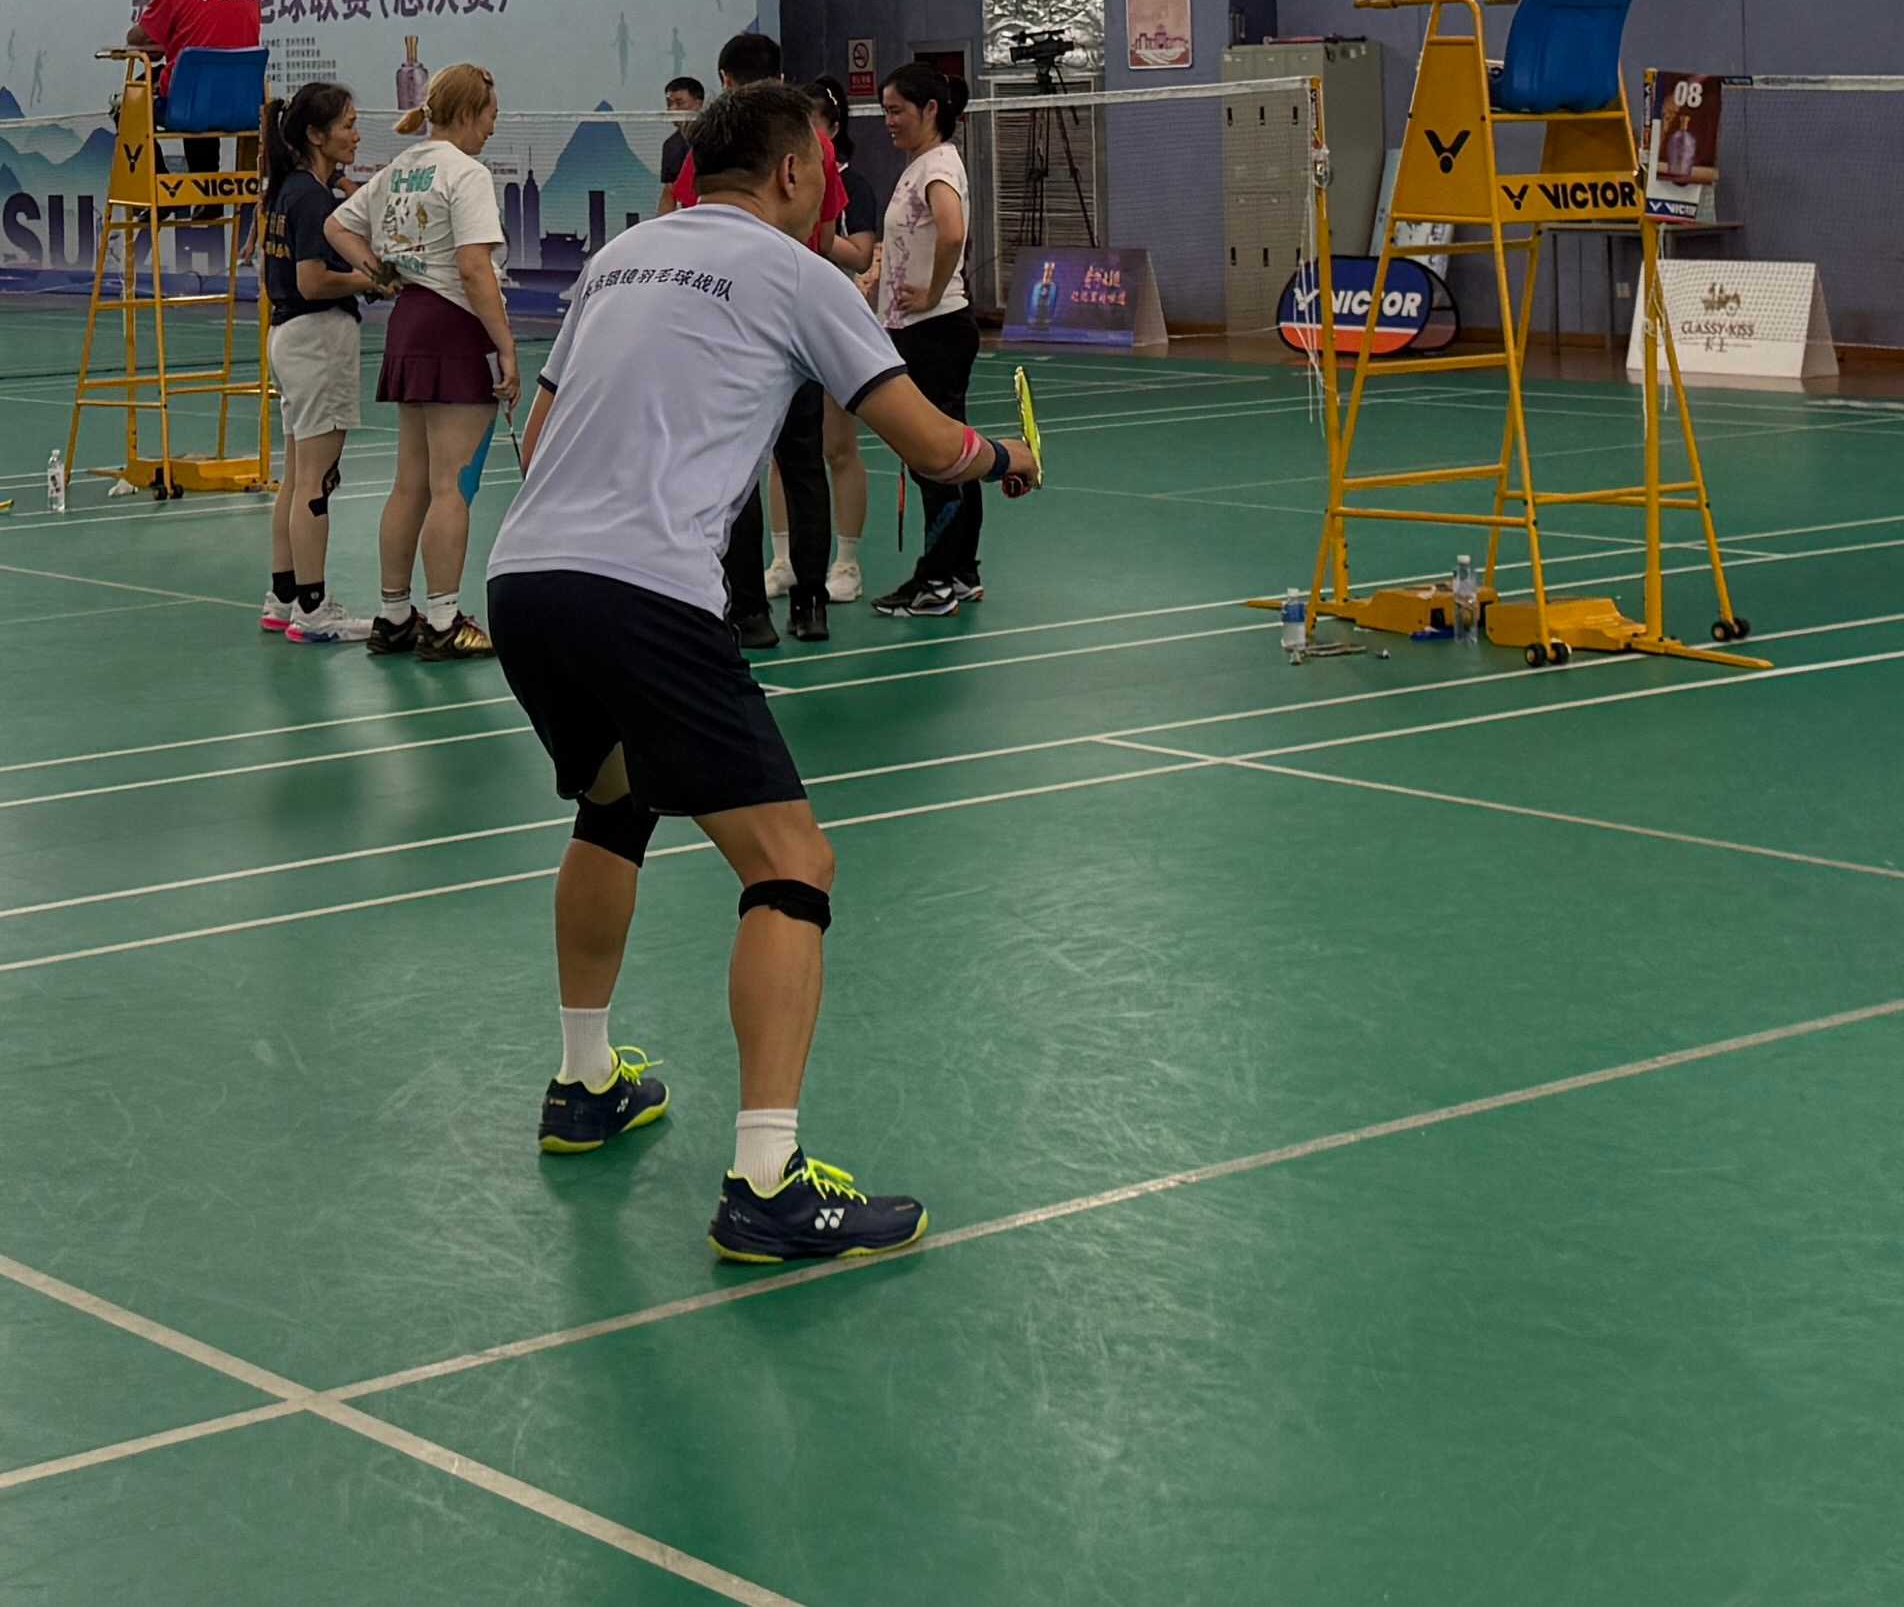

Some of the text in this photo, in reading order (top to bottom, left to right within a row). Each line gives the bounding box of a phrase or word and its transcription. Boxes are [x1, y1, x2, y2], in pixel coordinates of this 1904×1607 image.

[1673, 81, 1704, 108] 08
[192, 177, 259, 196] VICTO
[1539, 180, 1637, 210] VICTOR
[1331, 289, 1423, 318] VICOR
